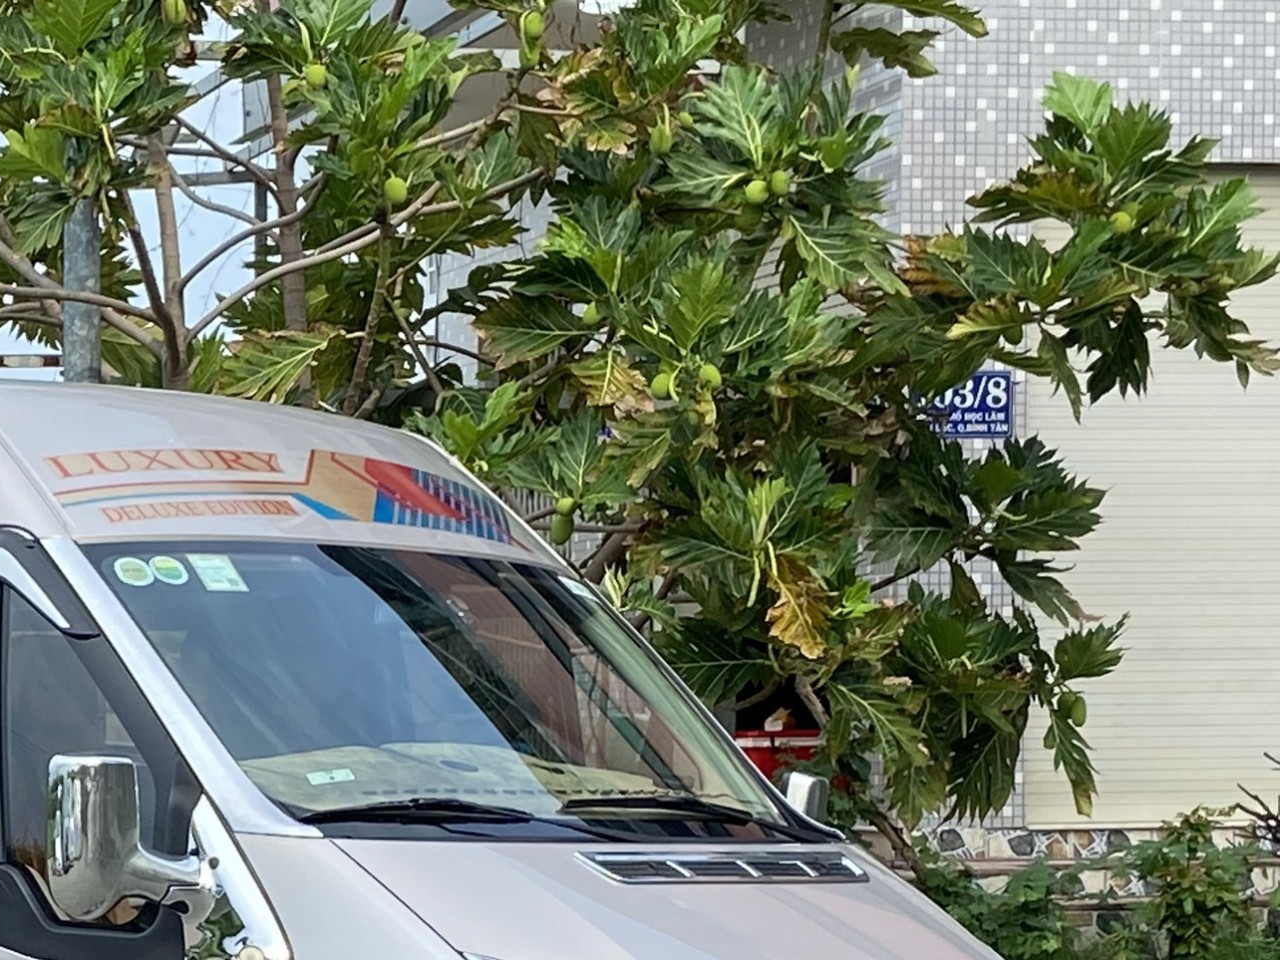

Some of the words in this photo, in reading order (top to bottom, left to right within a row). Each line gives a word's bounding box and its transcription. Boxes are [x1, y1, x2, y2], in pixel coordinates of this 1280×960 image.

[48, 450, 283, 478] LUXURY
[101, 501, 203, 523] DELUXE
[208, 500, 300, 517] EDITION
